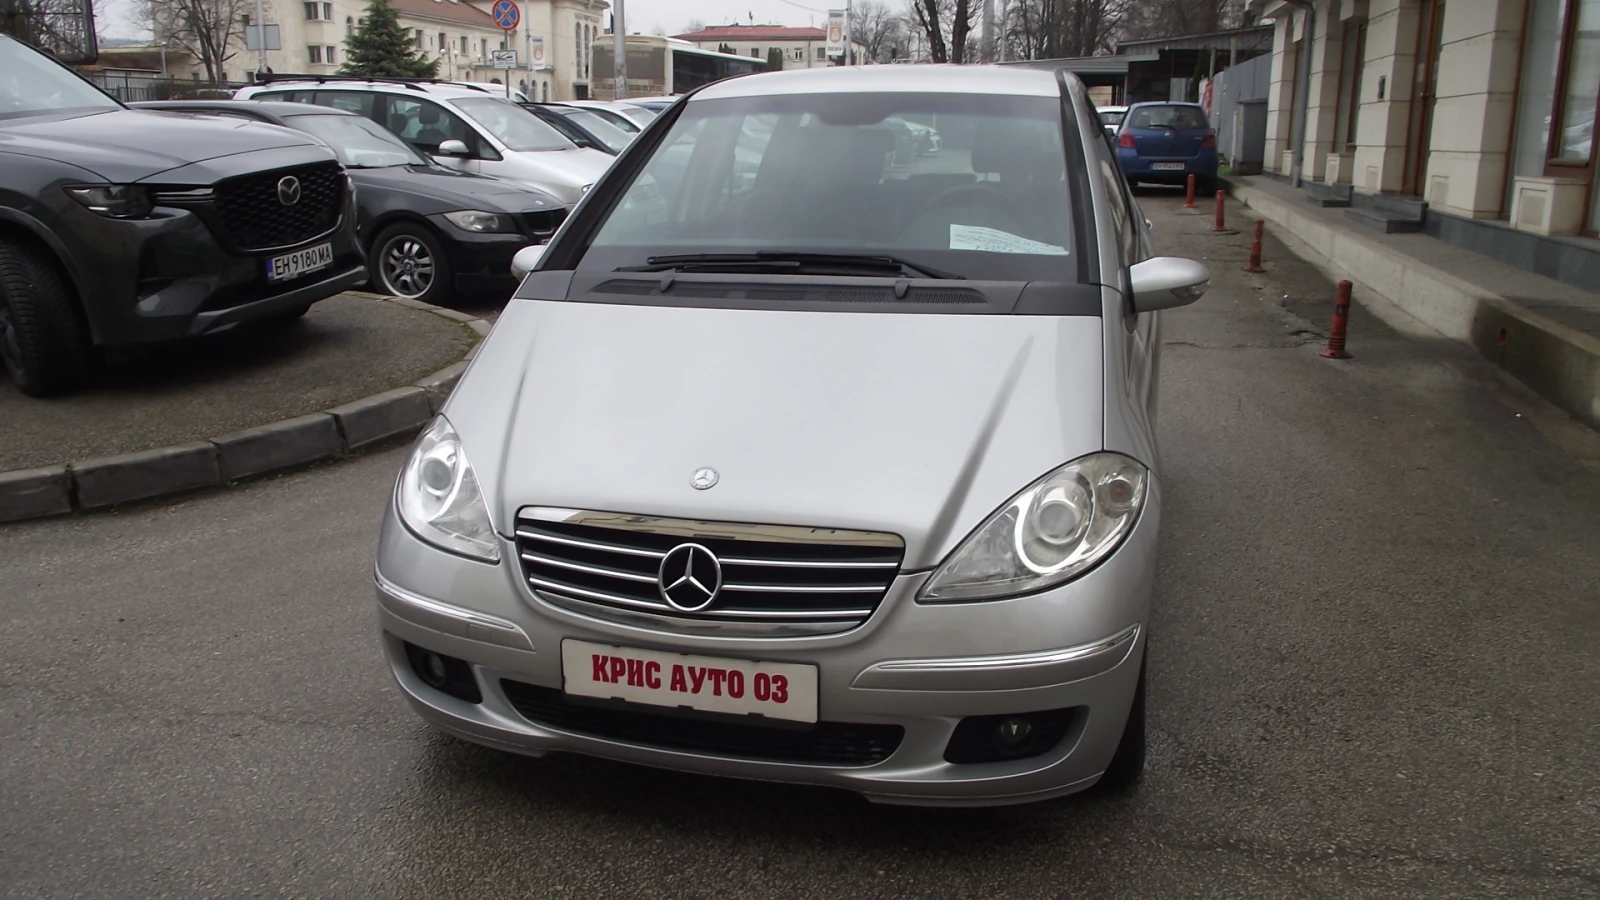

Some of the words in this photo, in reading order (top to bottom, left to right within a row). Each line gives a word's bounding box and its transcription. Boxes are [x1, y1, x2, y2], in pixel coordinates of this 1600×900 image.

[275, 256, 290, 276] EH
[292, 250, 317, 272] 9180
[318, 246, 331, 263] MA
[592, 654, 661, 690] КРИС
[669, 664, 745, 699] АУТО
[753, 672, 789, 704] 03
